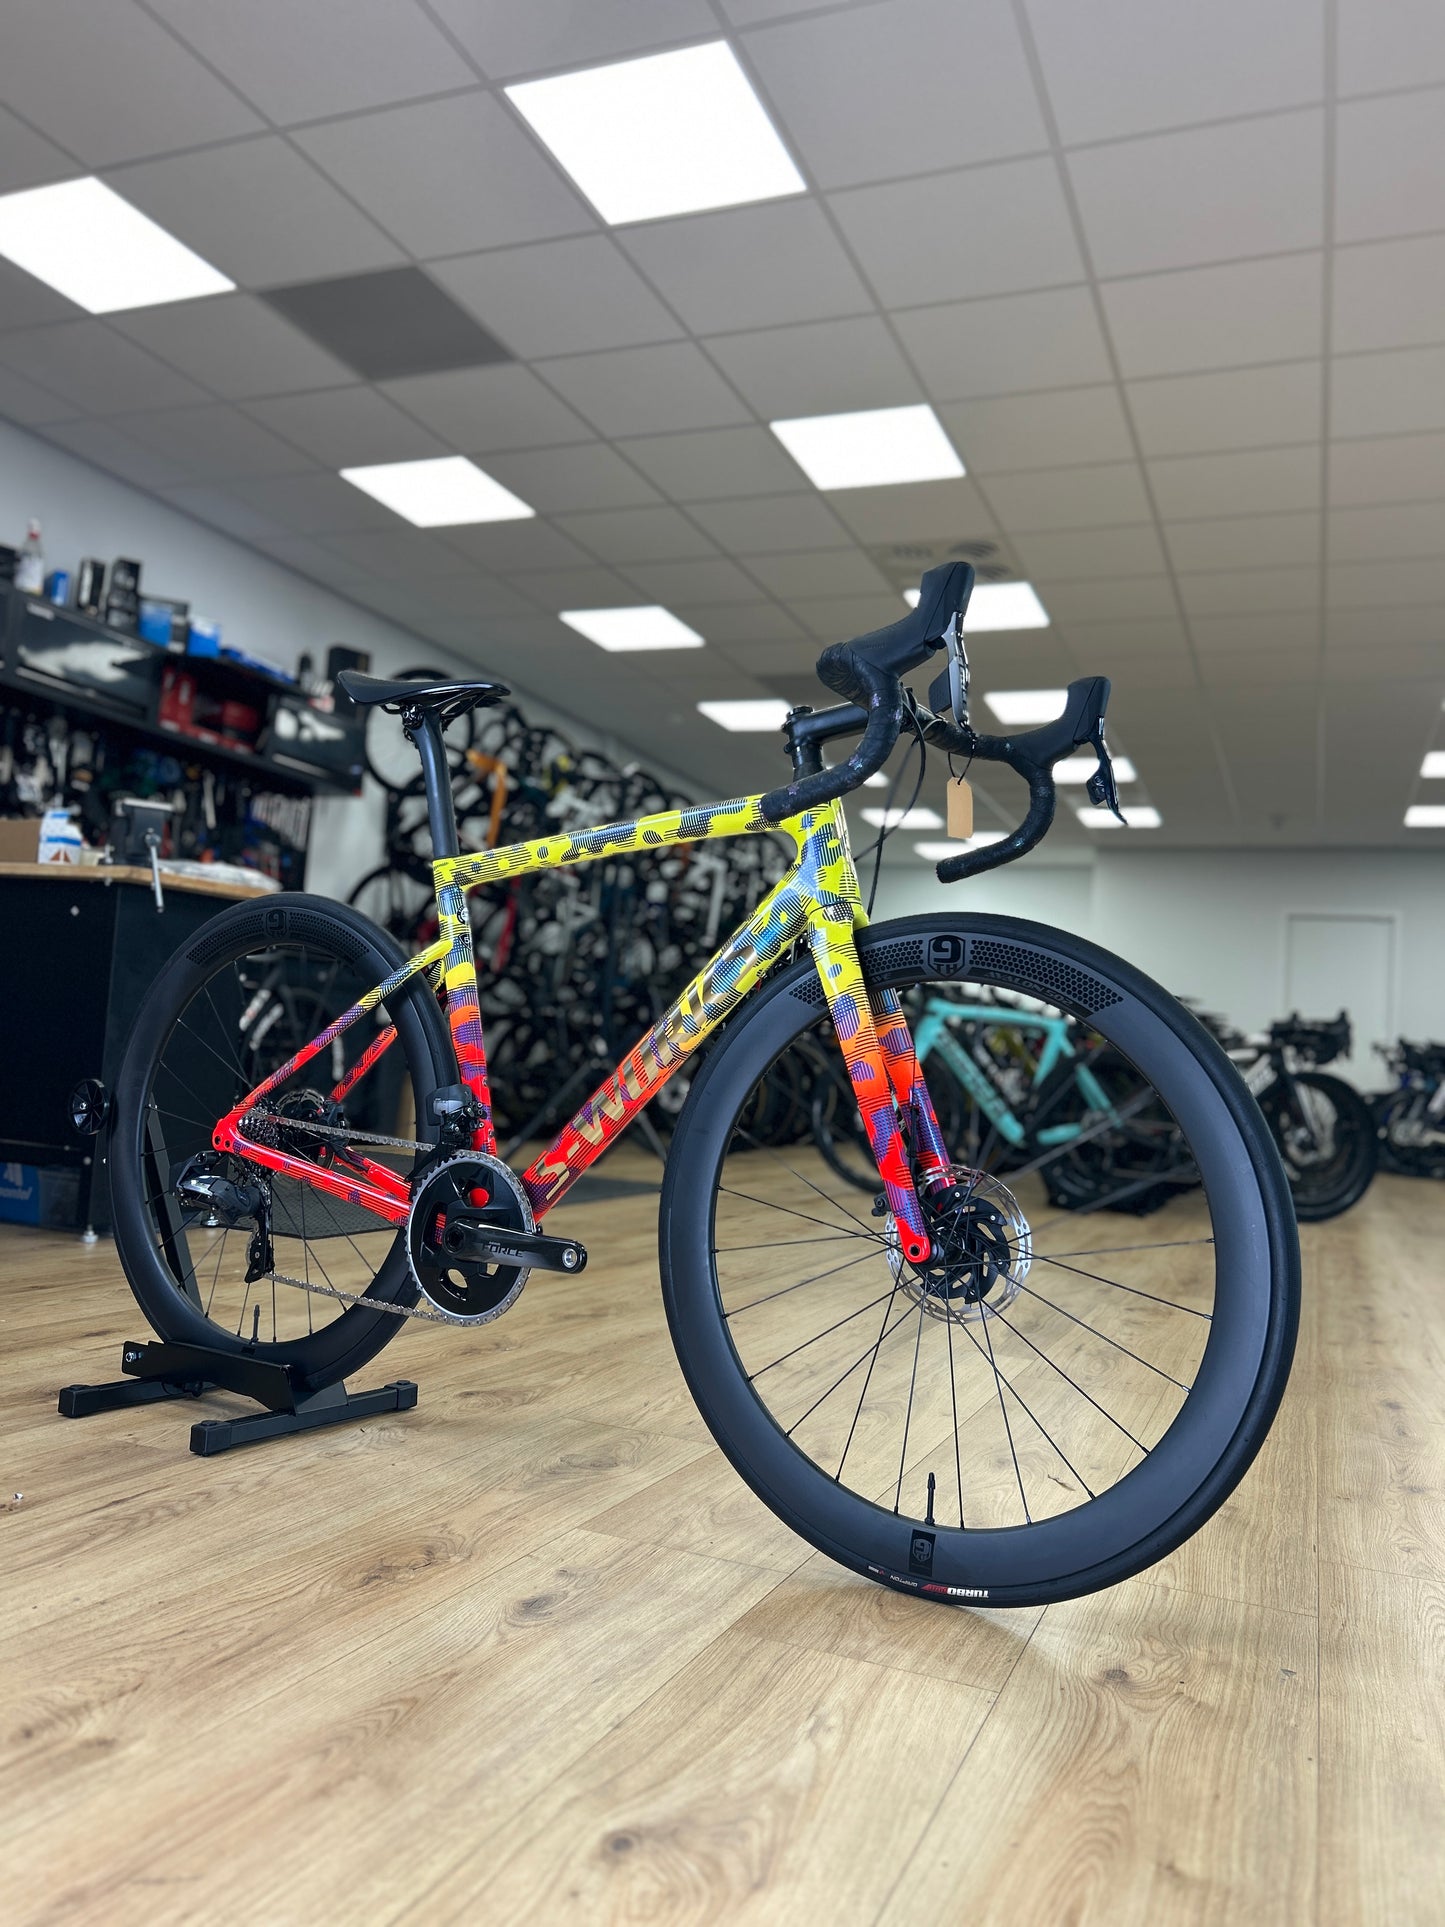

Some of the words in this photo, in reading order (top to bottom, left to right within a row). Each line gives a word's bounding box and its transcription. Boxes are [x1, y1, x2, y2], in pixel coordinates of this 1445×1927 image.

[932, 935, 961, 963] 9
[535, 941, 759, 1200] S-WORKS
[482, 1242, 524, 1258] FORCE
[946, 1586, 989, 1599] TURBO
